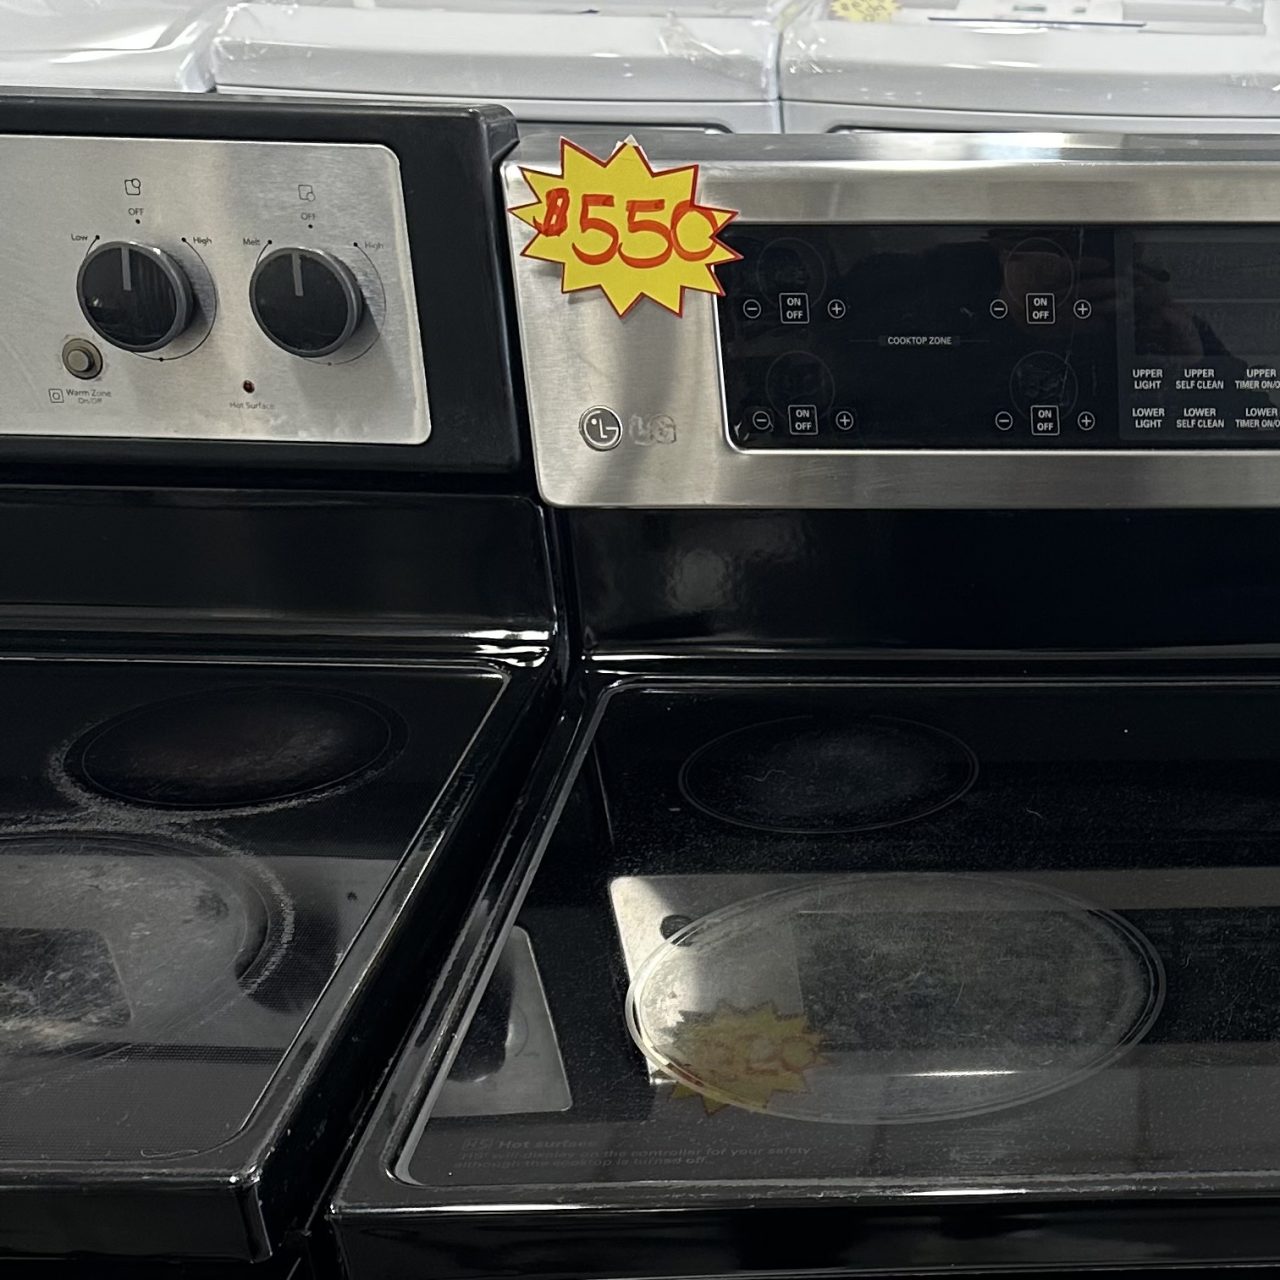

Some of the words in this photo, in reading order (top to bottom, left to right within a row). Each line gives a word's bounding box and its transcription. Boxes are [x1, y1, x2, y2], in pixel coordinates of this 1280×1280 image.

[128, 208, 144, 216] OFF
[533, 187, 721, 269] $550
[71, 233, 88, 241] Low
[193, 237, 213, 246] High
[242, 238, 261, 246] Melt
[365, 241, 384, 250] High
[786, 298, 801, 306] ON
[1033, 298, 1048, 306] ON
[786, 311, 803, 319] OFF
[1032, 311, 1049, 319] OFF
[887, 336, 928, 345] COOKTOP
[929, 336, 952, 345] ZONE
[1132, 369, 1163, 378] UPPER
[1184, 369, 1215, 378] UPPER
[1246, 369, 1276, 378] UPPER
[1134, 380, 1162, 390] LIGHT
[1175, 380, 1195, 390] SELF
[1197, 380, 1224, 390] CLEAN
[1235, 380, 1260, 390] TIMER
[66, 389, 89, 397] Warm
[91, 389, 112, 398] Zone
[795, 409, 810, 418] ON
[1038, 410, 1052, 418] ON
[1132, 408, 1165, 417] LOWER
[1183, 408, 1217, 417] LOWER
[1245, 408, 1278, 417] LOWER
[795, 422, 812, 431] OFF
[1037, 423, 1054, 431] OFF
[1135, 419, 1162, 428] LIGHT
[1176, 419, 1196, 428] SELF
[1197, 419, 1225, 428] CLEAN
[1235, 419, 1260, 428] TIMER
[499, 1140, 530, 1149] Hot
[731, 1149, 763, 1157] your
[767, 1147, 811, 1157] safety
